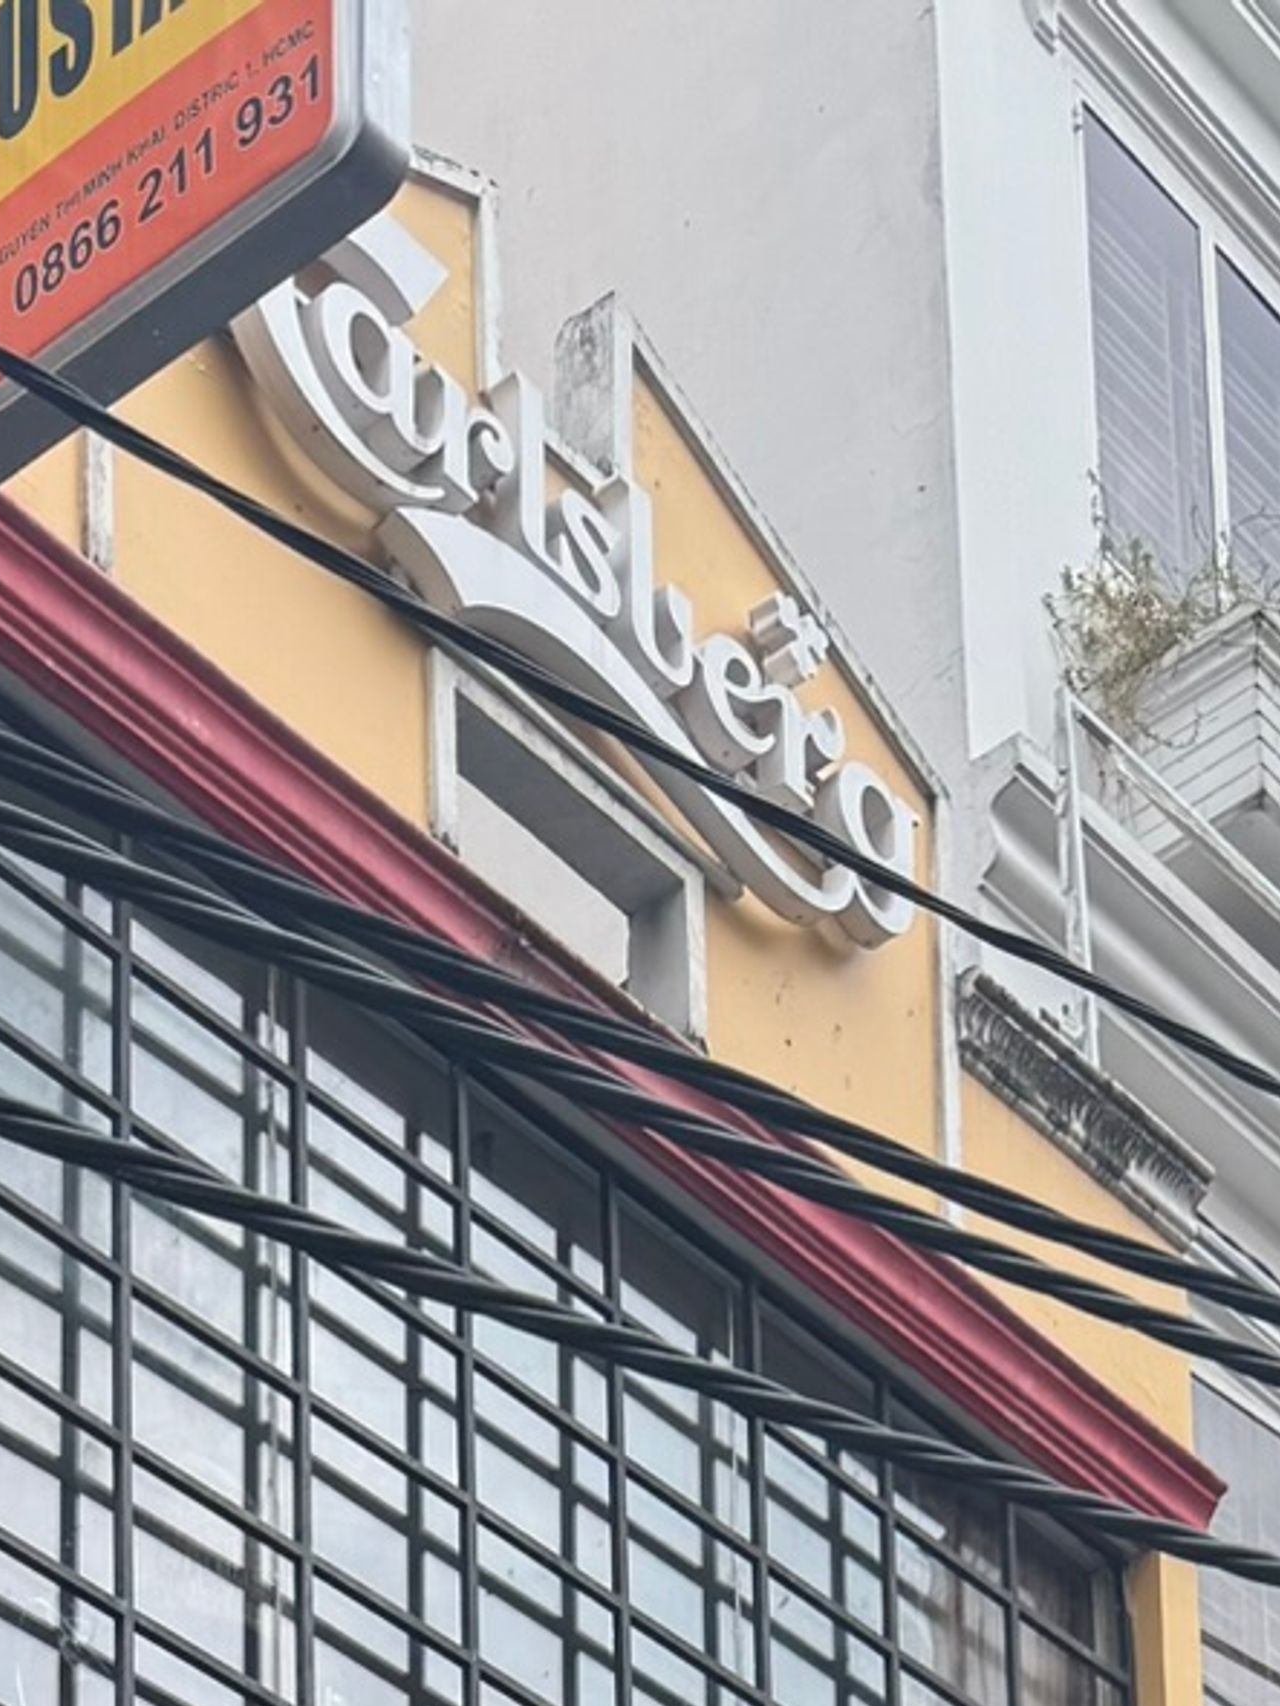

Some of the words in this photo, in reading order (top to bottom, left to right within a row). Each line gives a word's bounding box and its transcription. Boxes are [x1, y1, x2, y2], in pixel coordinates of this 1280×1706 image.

[14, 198, 121, 313] 0866
[137, 126, 213, 223] 211
[236, 54, 320, 148] 931
[250, 213, 922, 940] Carlsberg
